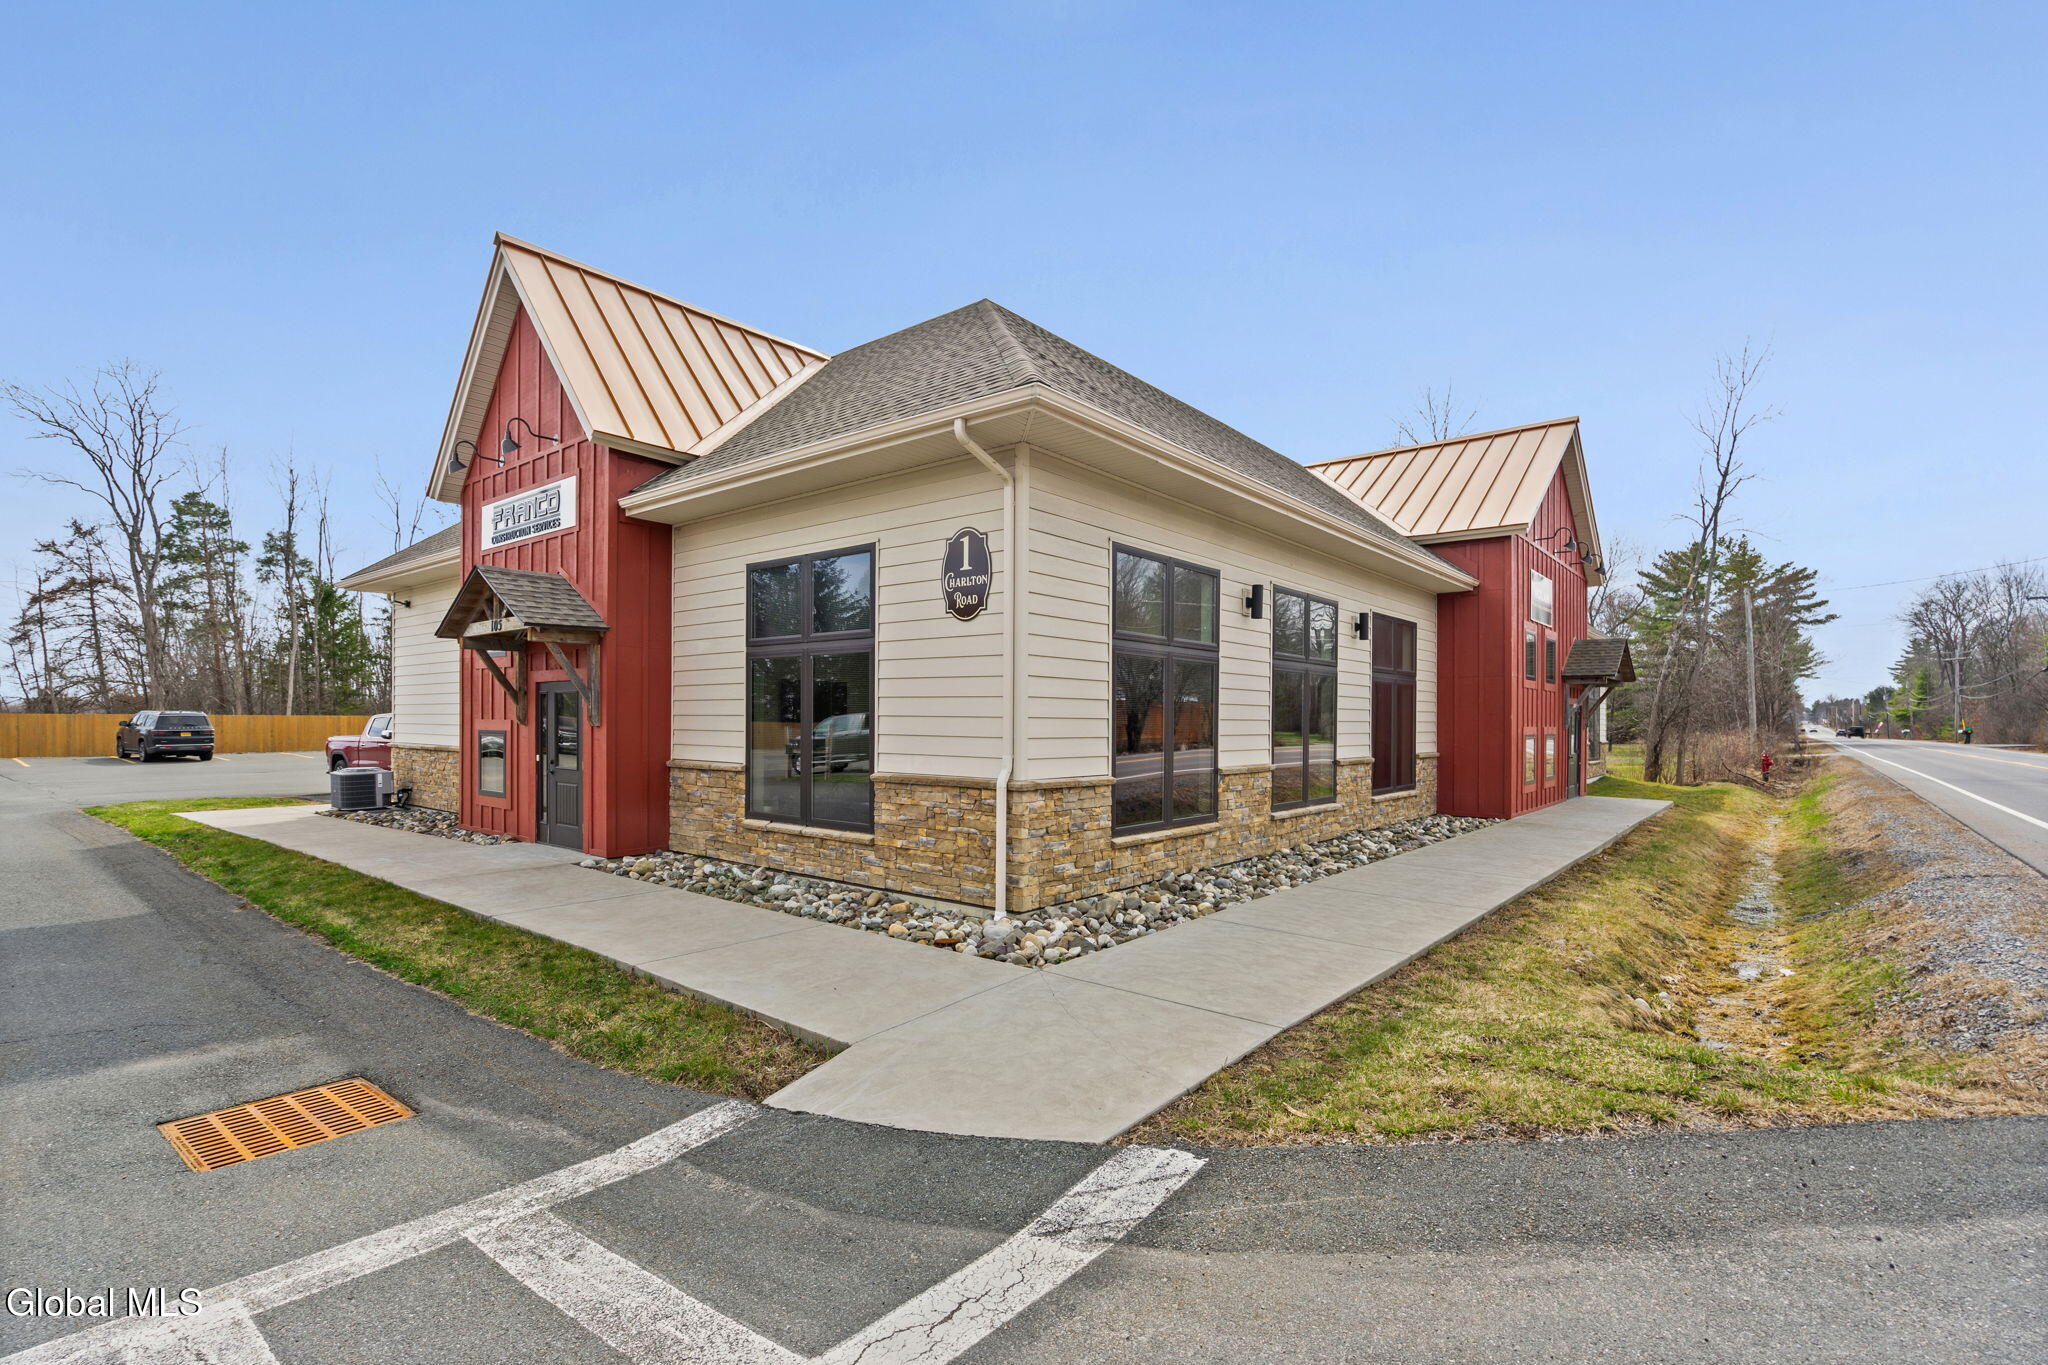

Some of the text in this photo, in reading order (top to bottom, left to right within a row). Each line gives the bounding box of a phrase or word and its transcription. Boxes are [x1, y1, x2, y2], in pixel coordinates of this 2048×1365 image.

[493, 489, 561, 531] FRANCO
[491, 517, 561, 545] CONSTRUCTION SERVICES
[959, 535, 972, 570] 1
[491, 619, 503, 632] 105
